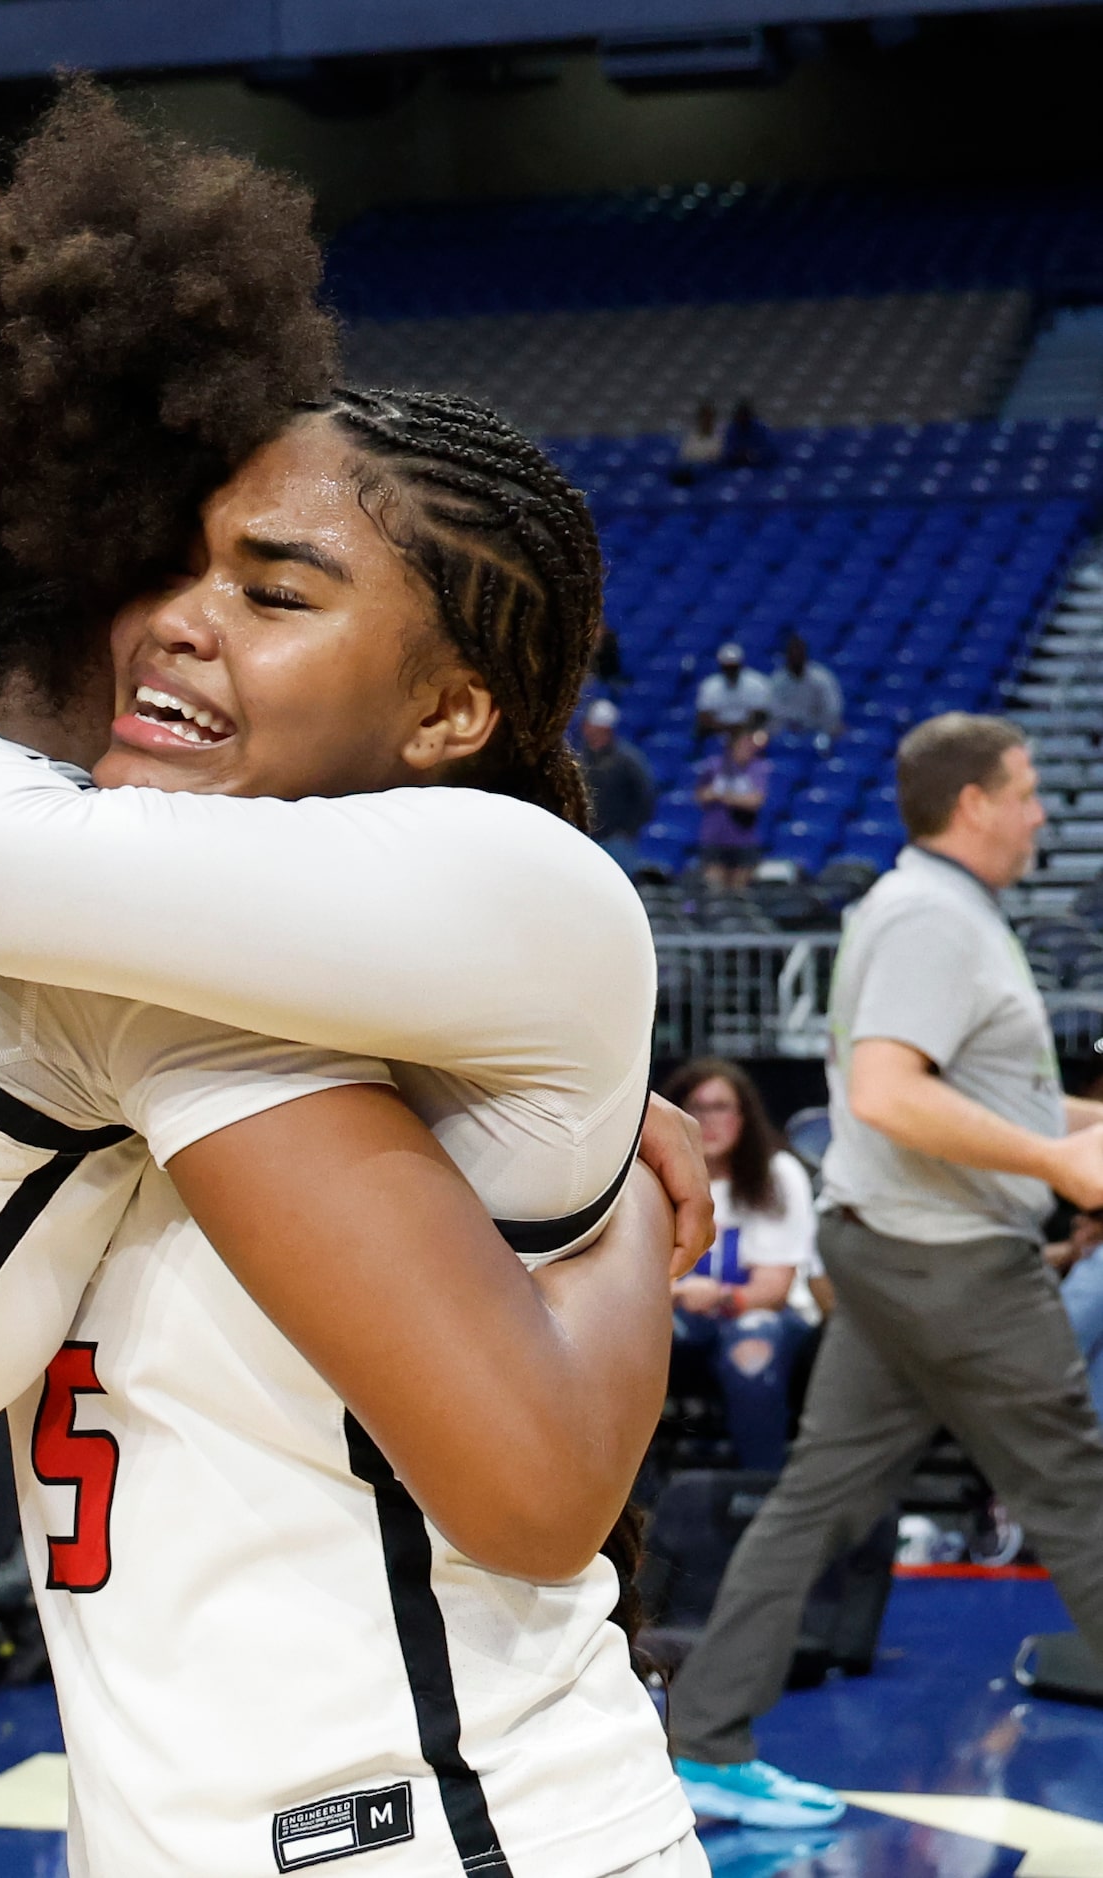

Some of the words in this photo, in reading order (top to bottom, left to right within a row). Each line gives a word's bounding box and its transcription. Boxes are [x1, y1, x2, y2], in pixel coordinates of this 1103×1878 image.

[31, 1340, 120, 1593] 5
[281, 1801, 351, 1827] ENGINEERED
[370, 1801, 394, 1829] M
